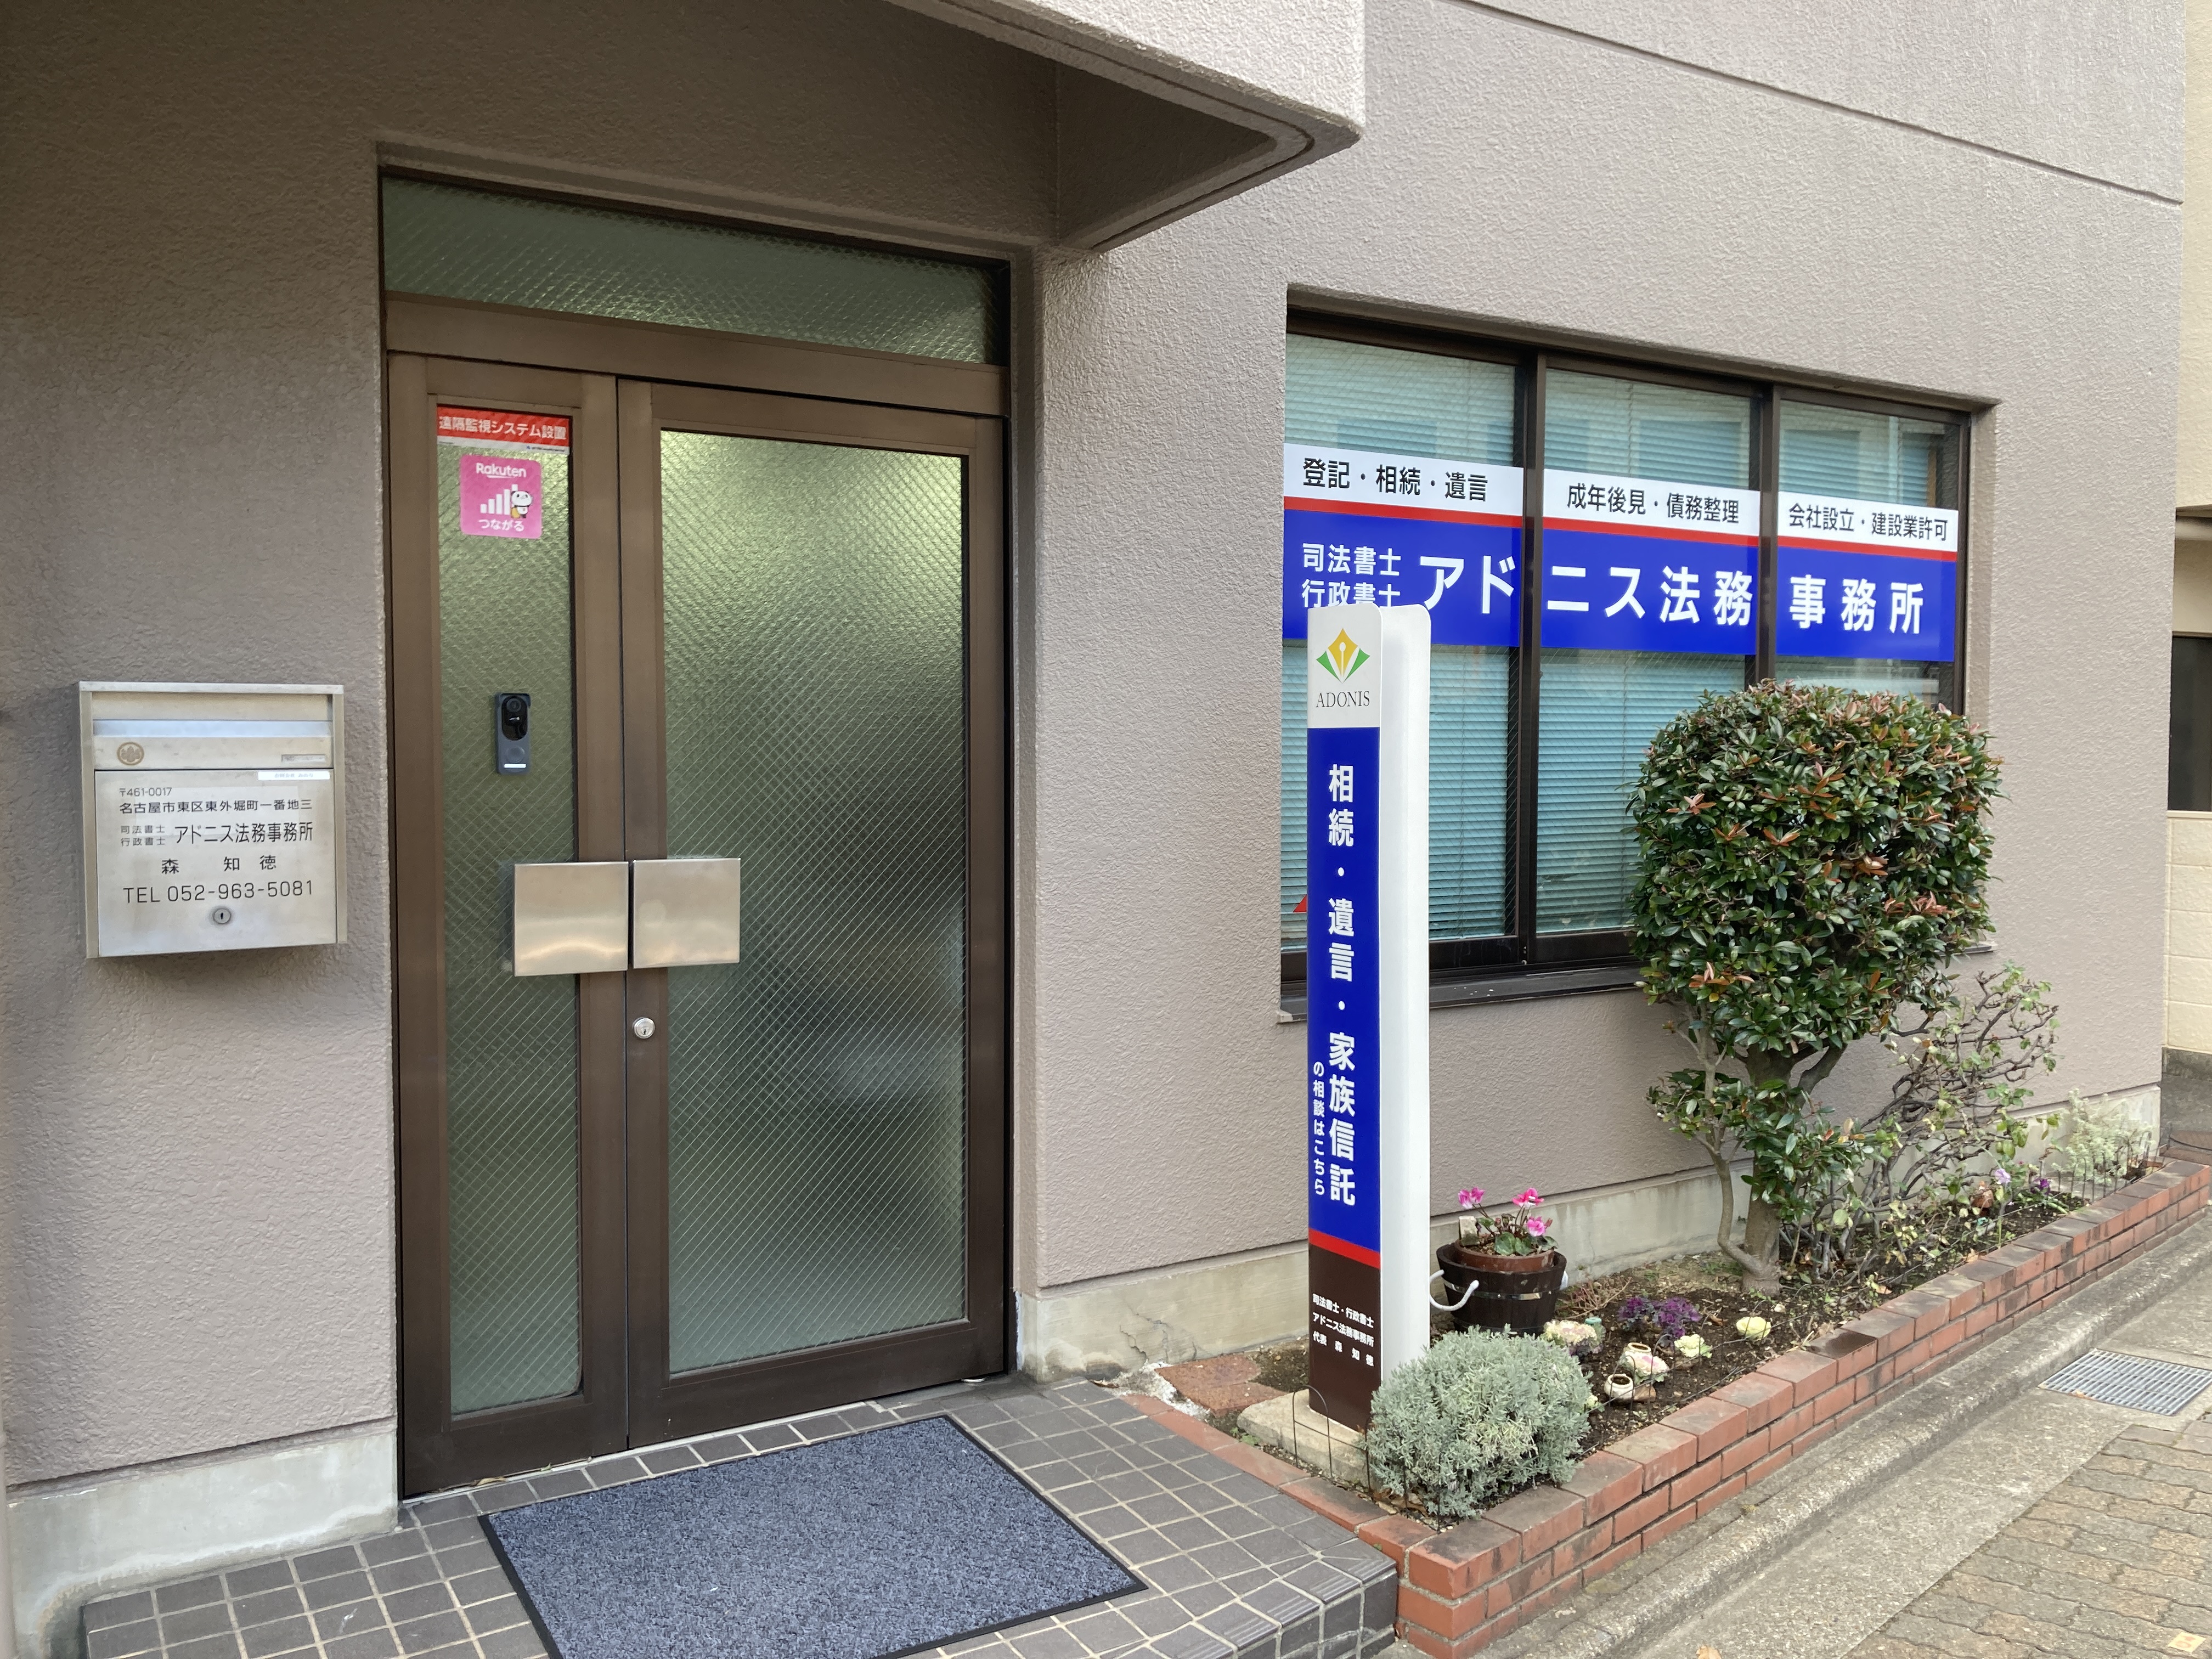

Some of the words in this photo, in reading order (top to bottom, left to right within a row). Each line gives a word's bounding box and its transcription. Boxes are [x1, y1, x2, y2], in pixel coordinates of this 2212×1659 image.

[439, 416, 566, 439] 遠隔監視システム設置
[476, 462, 527, 478] Rakuten
[1302, 458, 1488, 502] 登記・相続・遺言
[1567, 483, 1739, 523] 成年後見・債務整理
[479, 519, 524, 532] つながる
[1789, 503, 1948, 541] 会社設立・建設業許可
[1302, 543, 1401, 576] 司法書士
[1302, 578, 1401, 608] 行政書士
[1316, 691, 1370, 708] ADONIS
[120, 799, 312, 814] 名古屋市東区東外堀町一番地三
[121, 825, 166, 834] 司法書士
[174, 822, 313, 844] アドニス法務事務所
[121, 837, 166, 847] 行政書士
[123, 887, 160, 903] TEL
[168, 880, 312, 902] 052-963-5081
[1313, 1062, 1325, 1195] の相談はこちら
[1312, 1312, 1374, 1347] アドニス法務事務所
